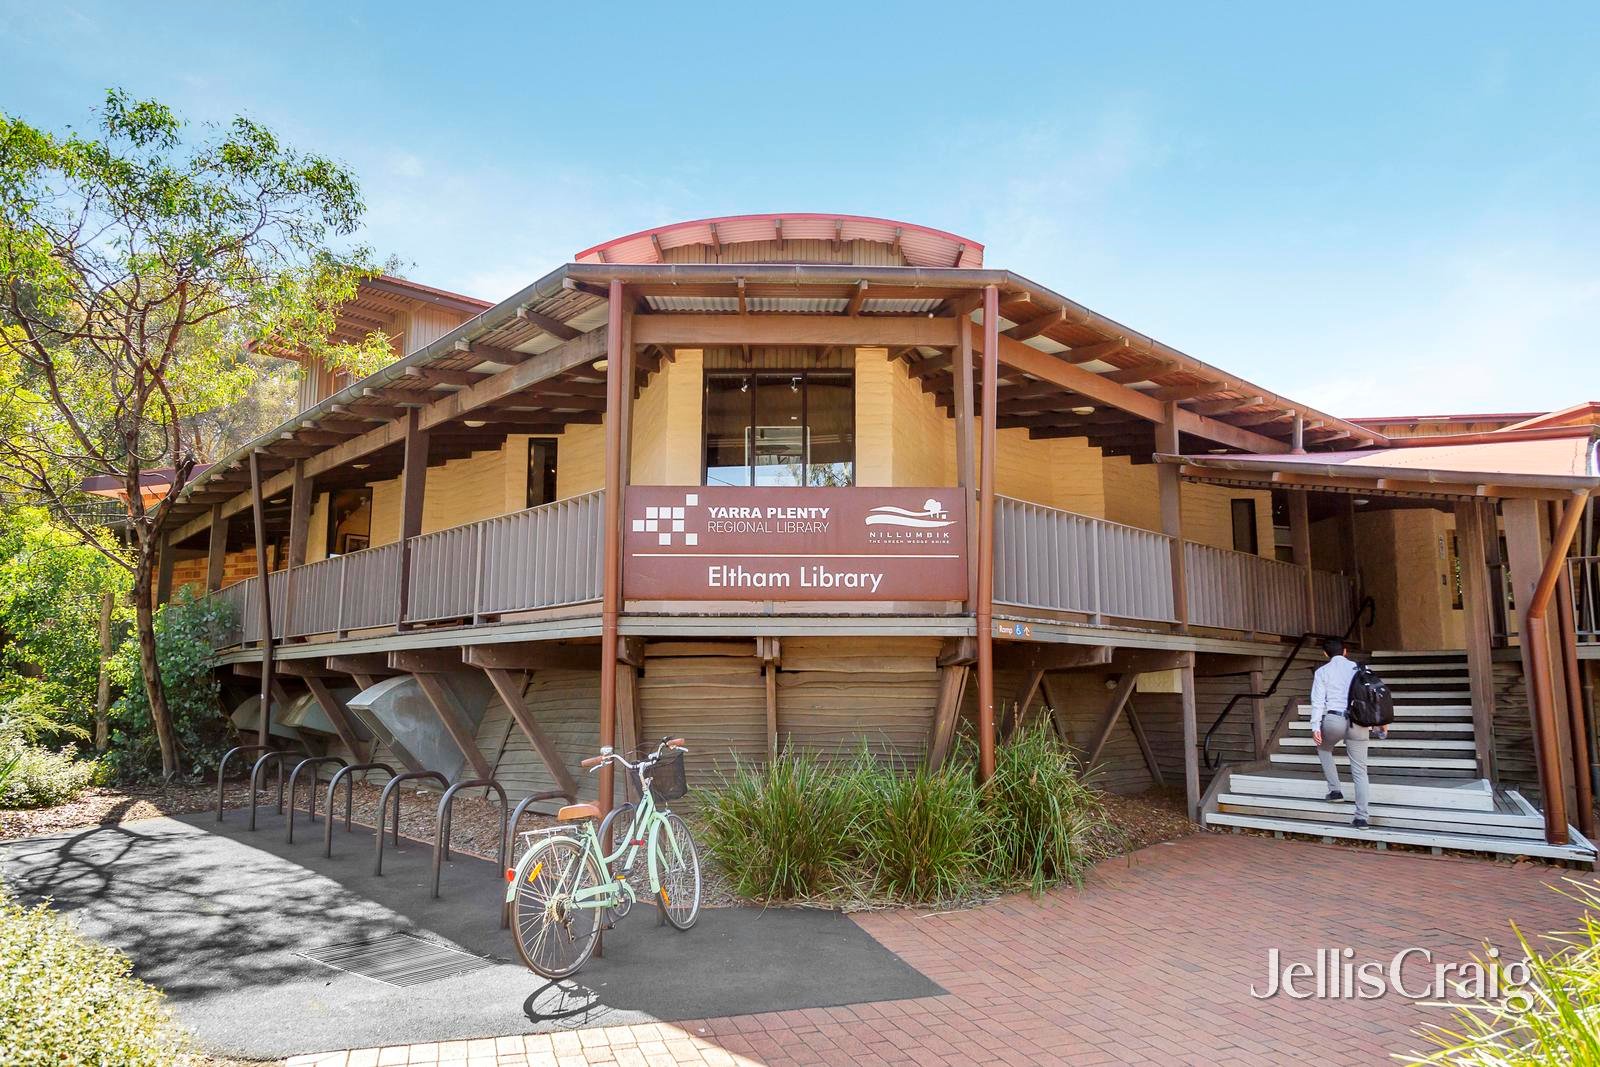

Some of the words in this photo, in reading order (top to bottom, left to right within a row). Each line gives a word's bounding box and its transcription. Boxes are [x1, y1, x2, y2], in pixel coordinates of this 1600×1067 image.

[707, 507, 762, 519] YARRA
[766, 507, 830, 519] PLENTY
[707, 521, 773, 533] REGIONAL
[776, 521, 830, 533] LIBRARY
[707, 565, 790, 588] Eltham
[800, 566, 883, 593] Library
